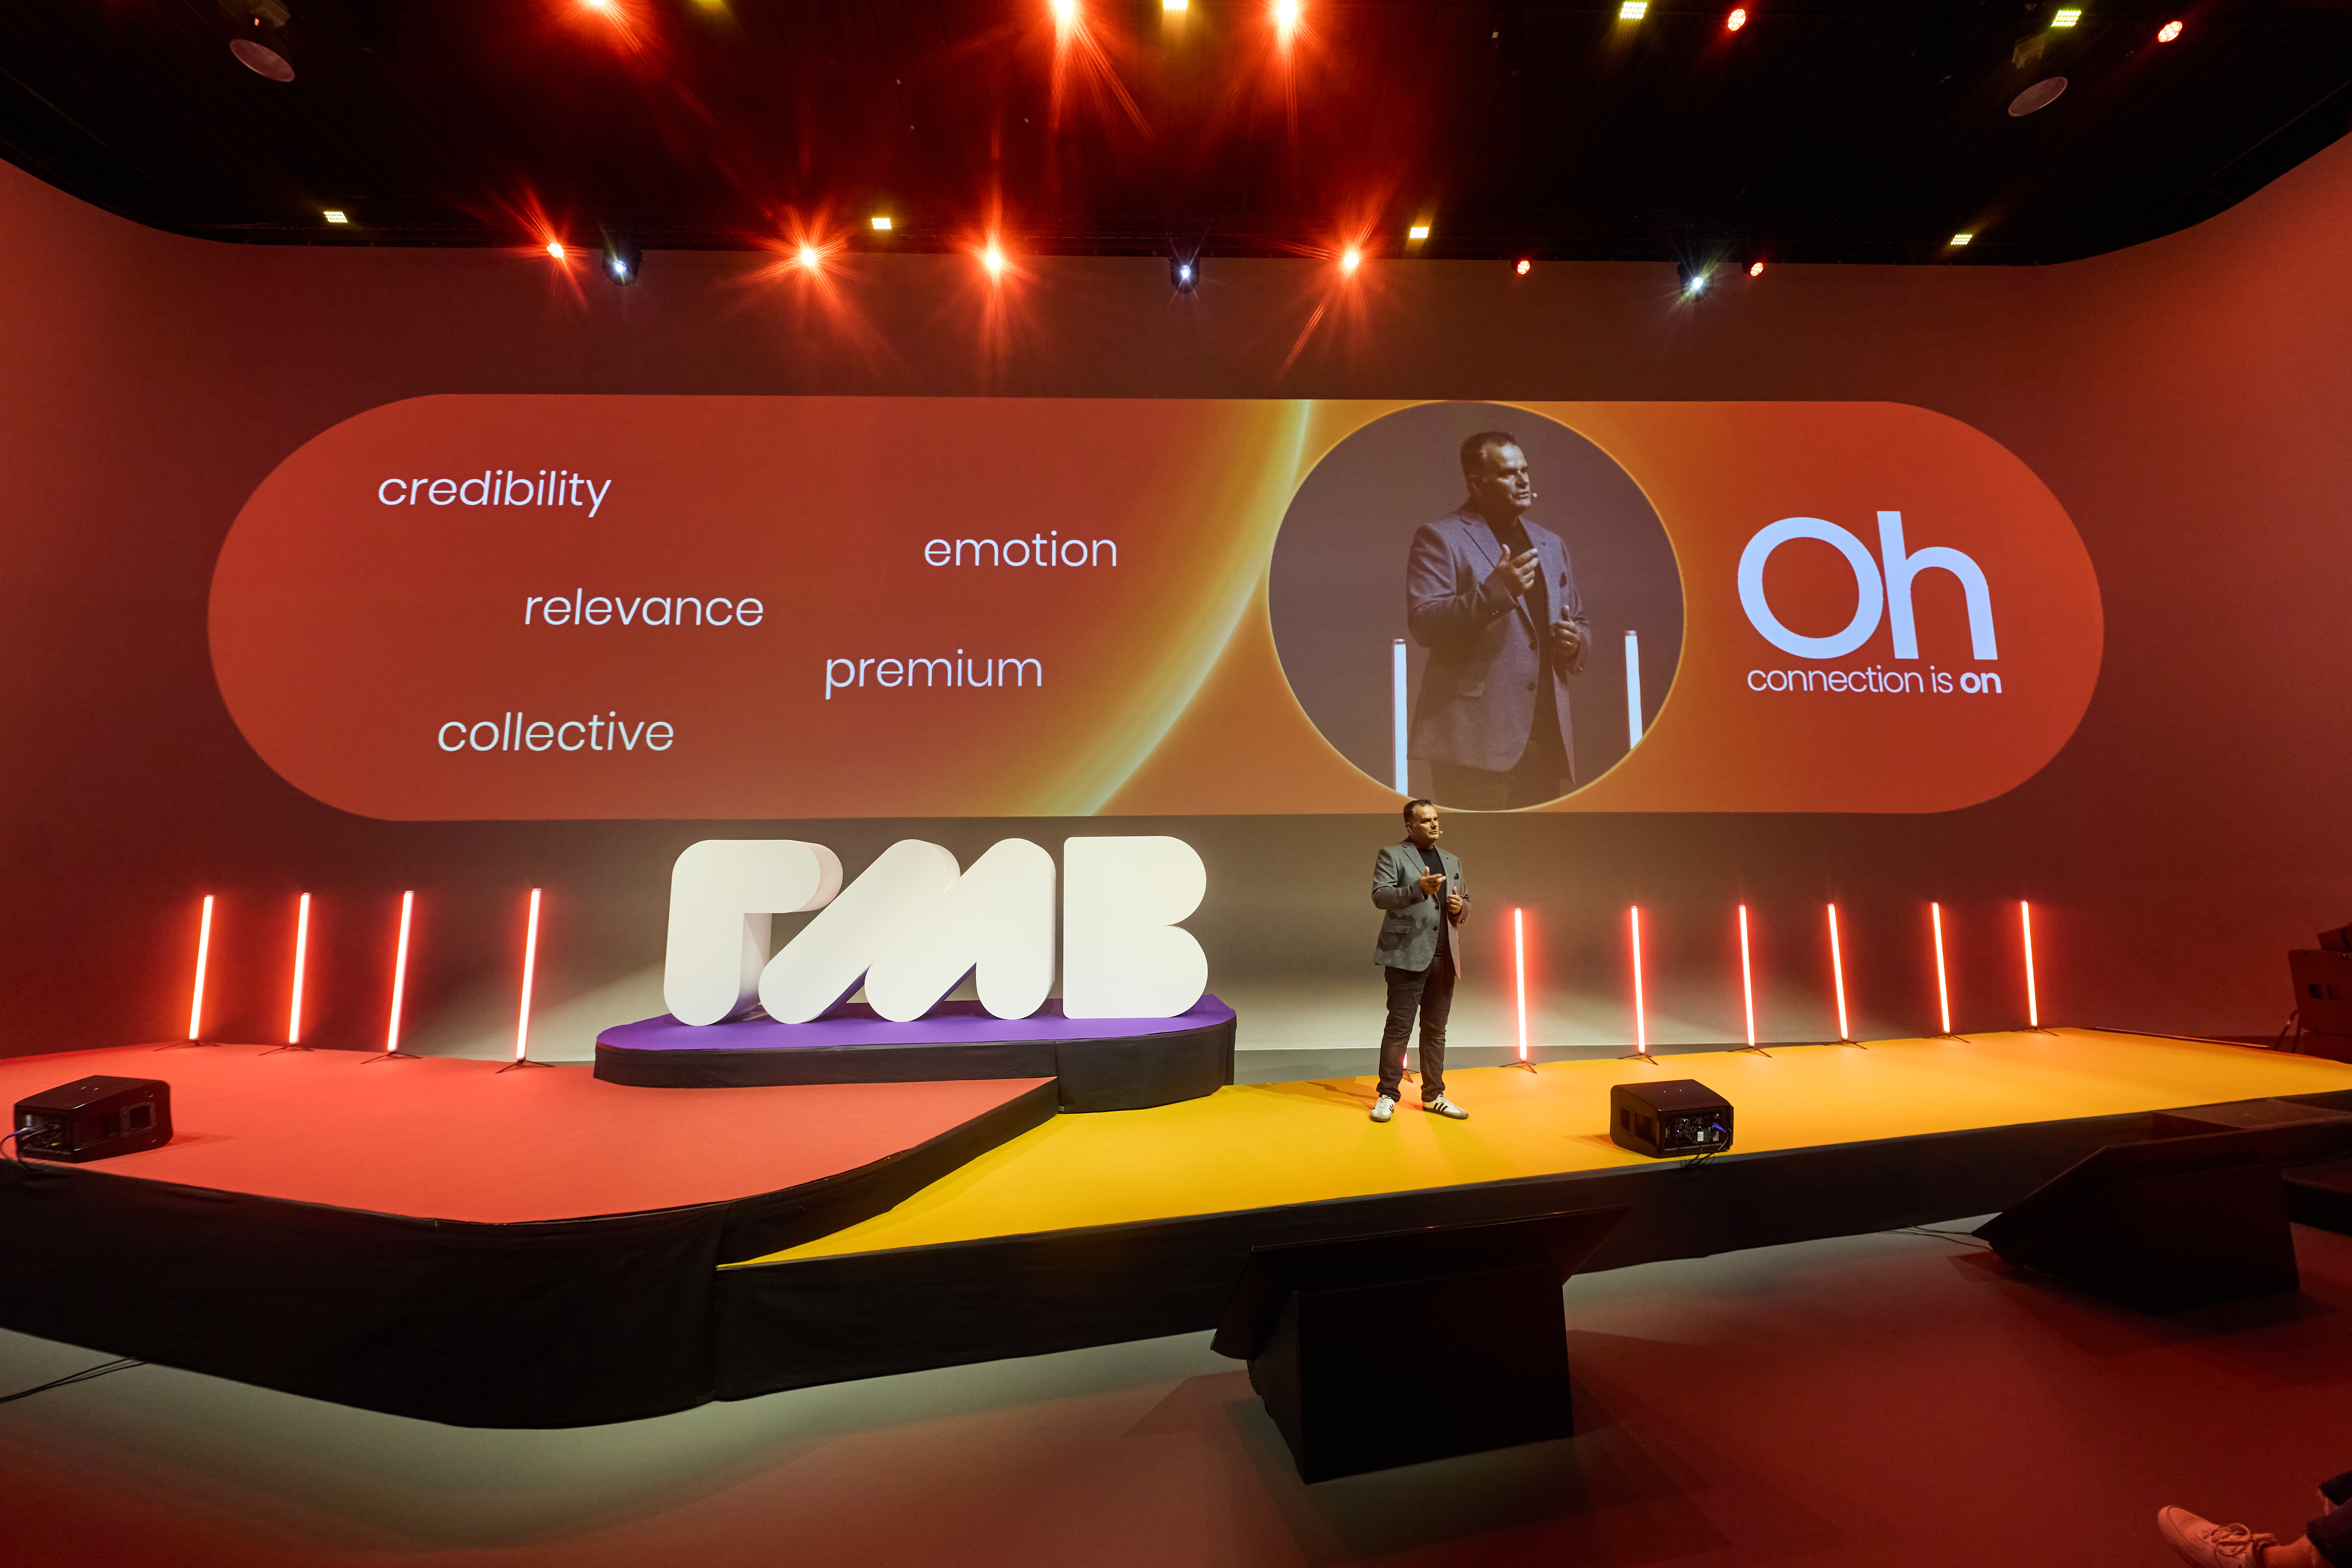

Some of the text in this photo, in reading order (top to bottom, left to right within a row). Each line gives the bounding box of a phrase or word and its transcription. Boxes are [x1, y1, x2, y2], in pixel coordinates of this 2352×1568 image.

[379, 470, 611, 517] credibility
[925, 530, 1116, 566] emotion
[1737, 511, 1998, 660] Oh
[525, 588, 763, 626] relevance
[825, 649, 1042, 700] premium
[1748, 665, 2002, 693] connection is on
[439, 711, 673, 751] collective
